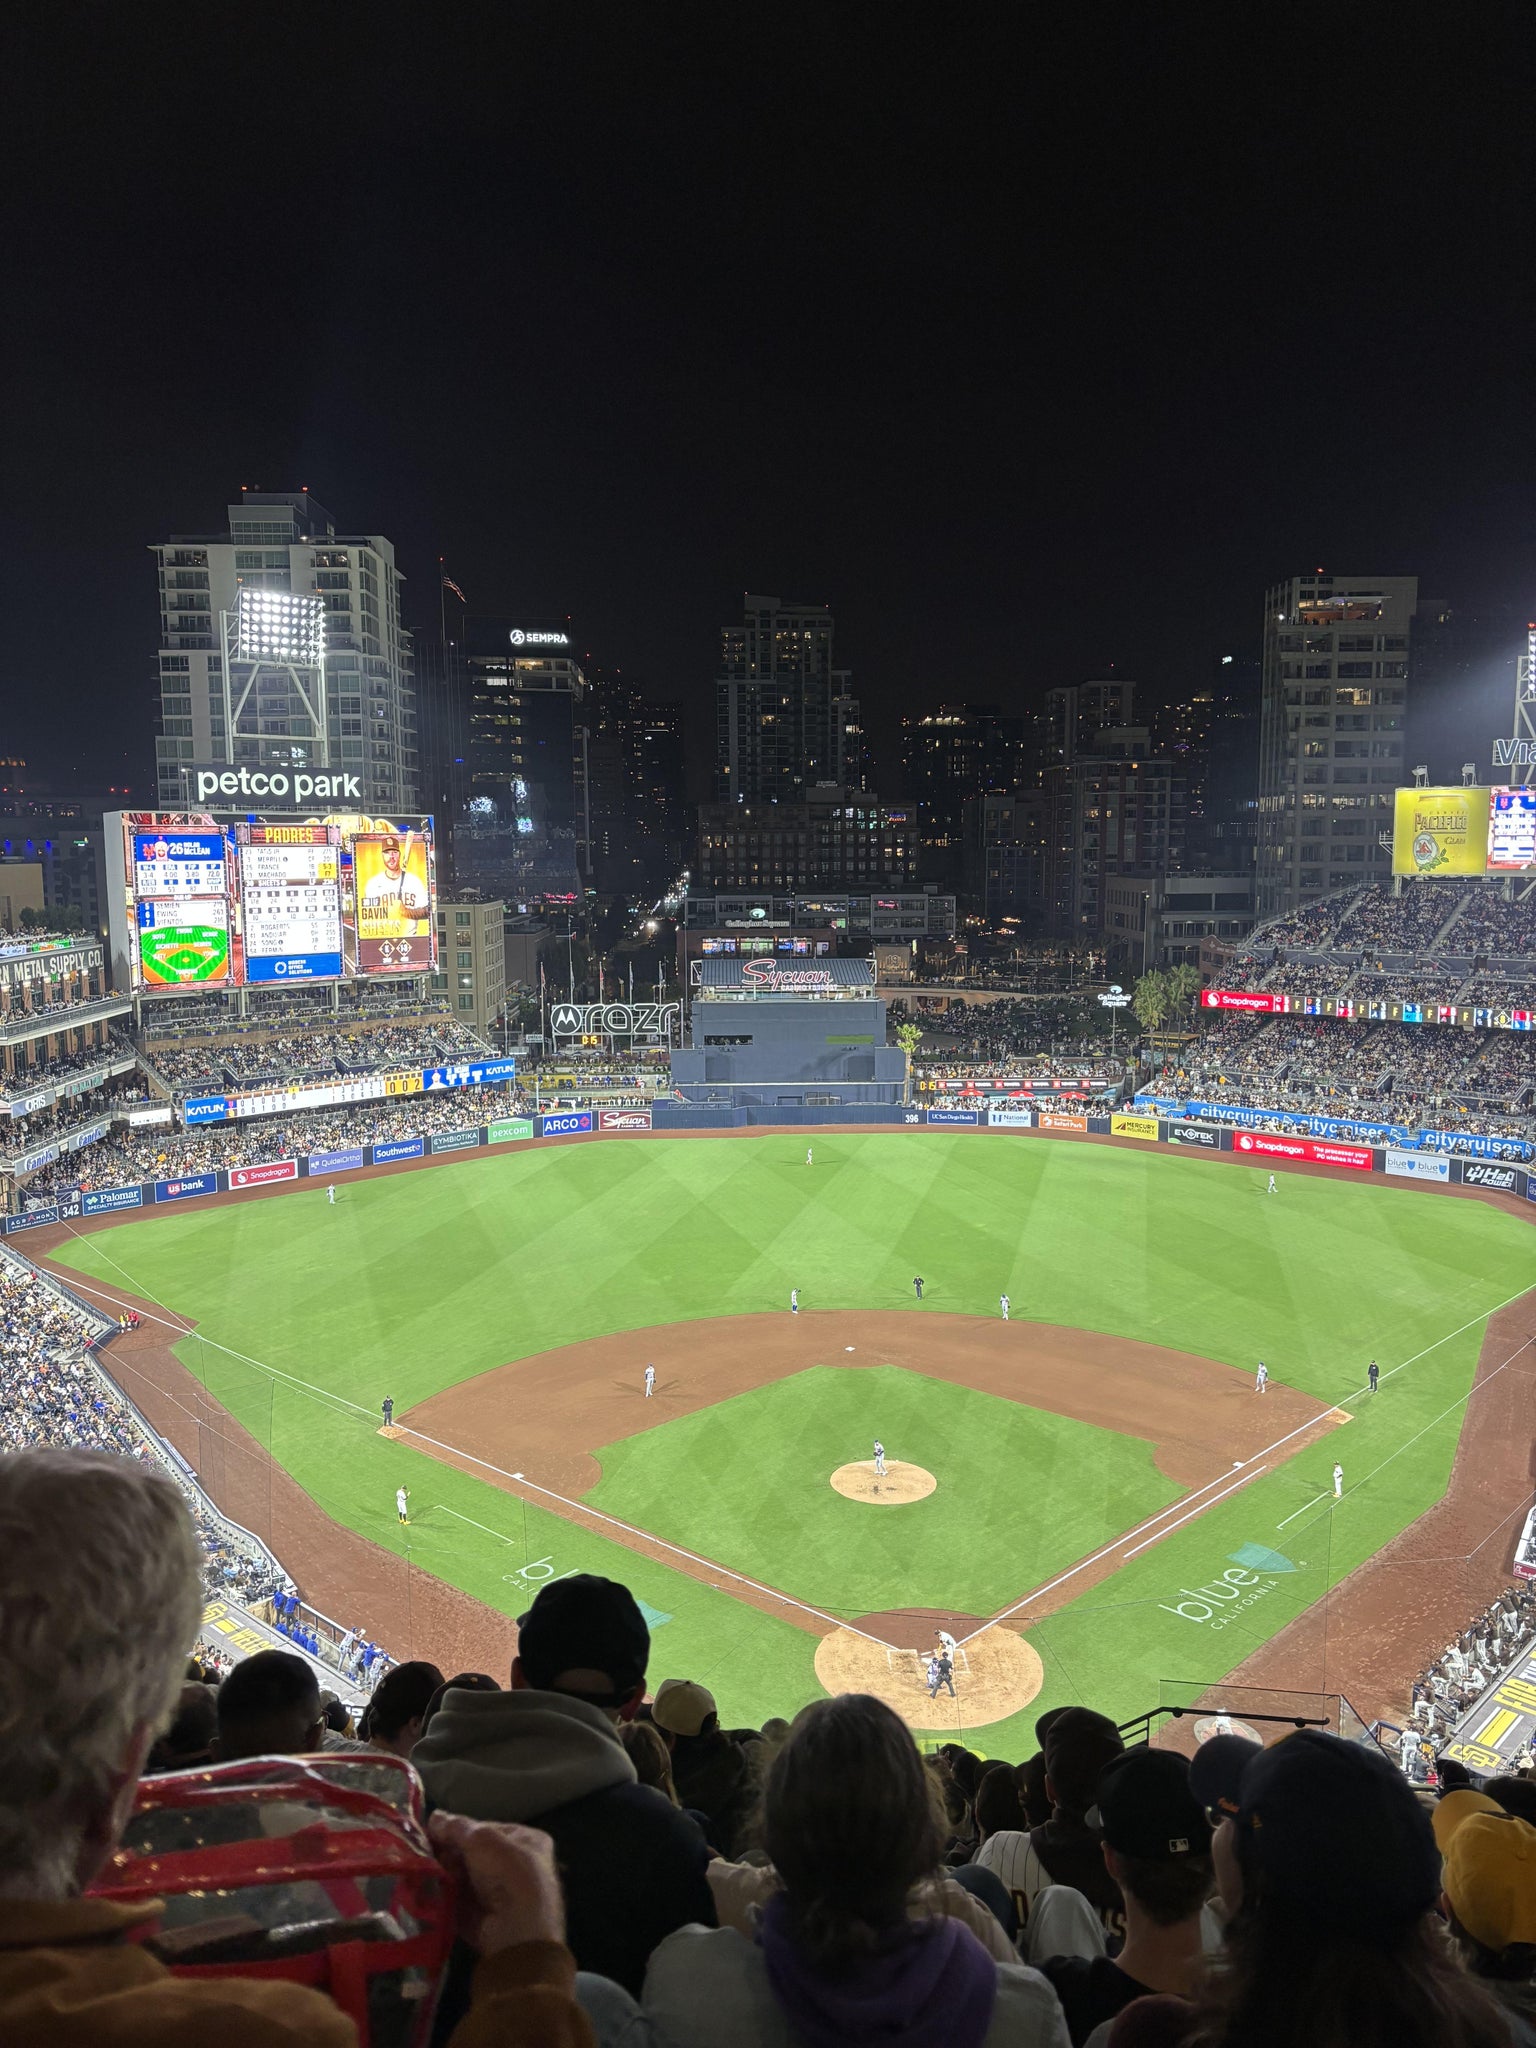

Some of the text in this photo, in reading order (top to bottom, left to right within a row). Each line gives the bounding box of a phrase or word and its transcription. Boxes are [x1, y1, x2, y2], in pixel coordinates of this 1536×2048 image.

[526, 633, 568, 643] SEMPRA
[198, 767, 361, 802] petco park
[265, 827, 313, 843] PADRES
[169, 842, 183, 854] 26
[362, 907, 388, 919] GAVIN
[725, 919, 790, 929] Gallagher Square
[14, 959, 48, 981] METAL
[50, 952, 84, 975] SUPPLY
[88, 949, 103, 967] CO.
[742, 958, 833, 991] Sycuan
[1097, 993, 1132, 1001] Gallagher
[1222, 997, 1269, 1007] Snapdragon
[585, 1003, 679, 1034] razr
[486, 1065, 513, 1075] KATUN
[390, 1078, 420, 1093] 0 0 2
[25, 1095, 46, 1112] ORIS
[187, 1104, 224, 1117] KATUN
[545, 1118, 579, 1131] ARCO
[603, 1112, 646, 1128] Sycuan
[905, 1114, 919, 1124] 396
[1127, 1122, 1155, 1130] MERCURY
[1127, 1127, 1155, 1135] INSURANCE
[433, 1132, 477, 1145] CYMBIOTIKA
[1174, 1128, 1213, 1140] EVOTEK
[376, 1145, 415, 1158] Southwest
[1256, 1140, 1304, 1155] Snapdragon
[1324, 1147, 1353, 1157] processor
[321, 1154, 361, 1167] QuidelOrtho
[1351, 1157, 1364, 1165] had
[1388, 1157, 1438, 1171] blue blue
[250, 1168, 290, 1179] Snapdragon
[181, 1179, 204, 1191] bank
[1480, 1178, 1512, 1188] POWER
[100, 1189, 138, 1203] Palomar
[88, 1198, 139, 1211] SPECIALTY INSURANCE
[62, 1205, 79, 1218] 342
[1158, 1568, 1259, 1623] blue
[1210, 1580, 1279, 1630] CALIFORNIA
